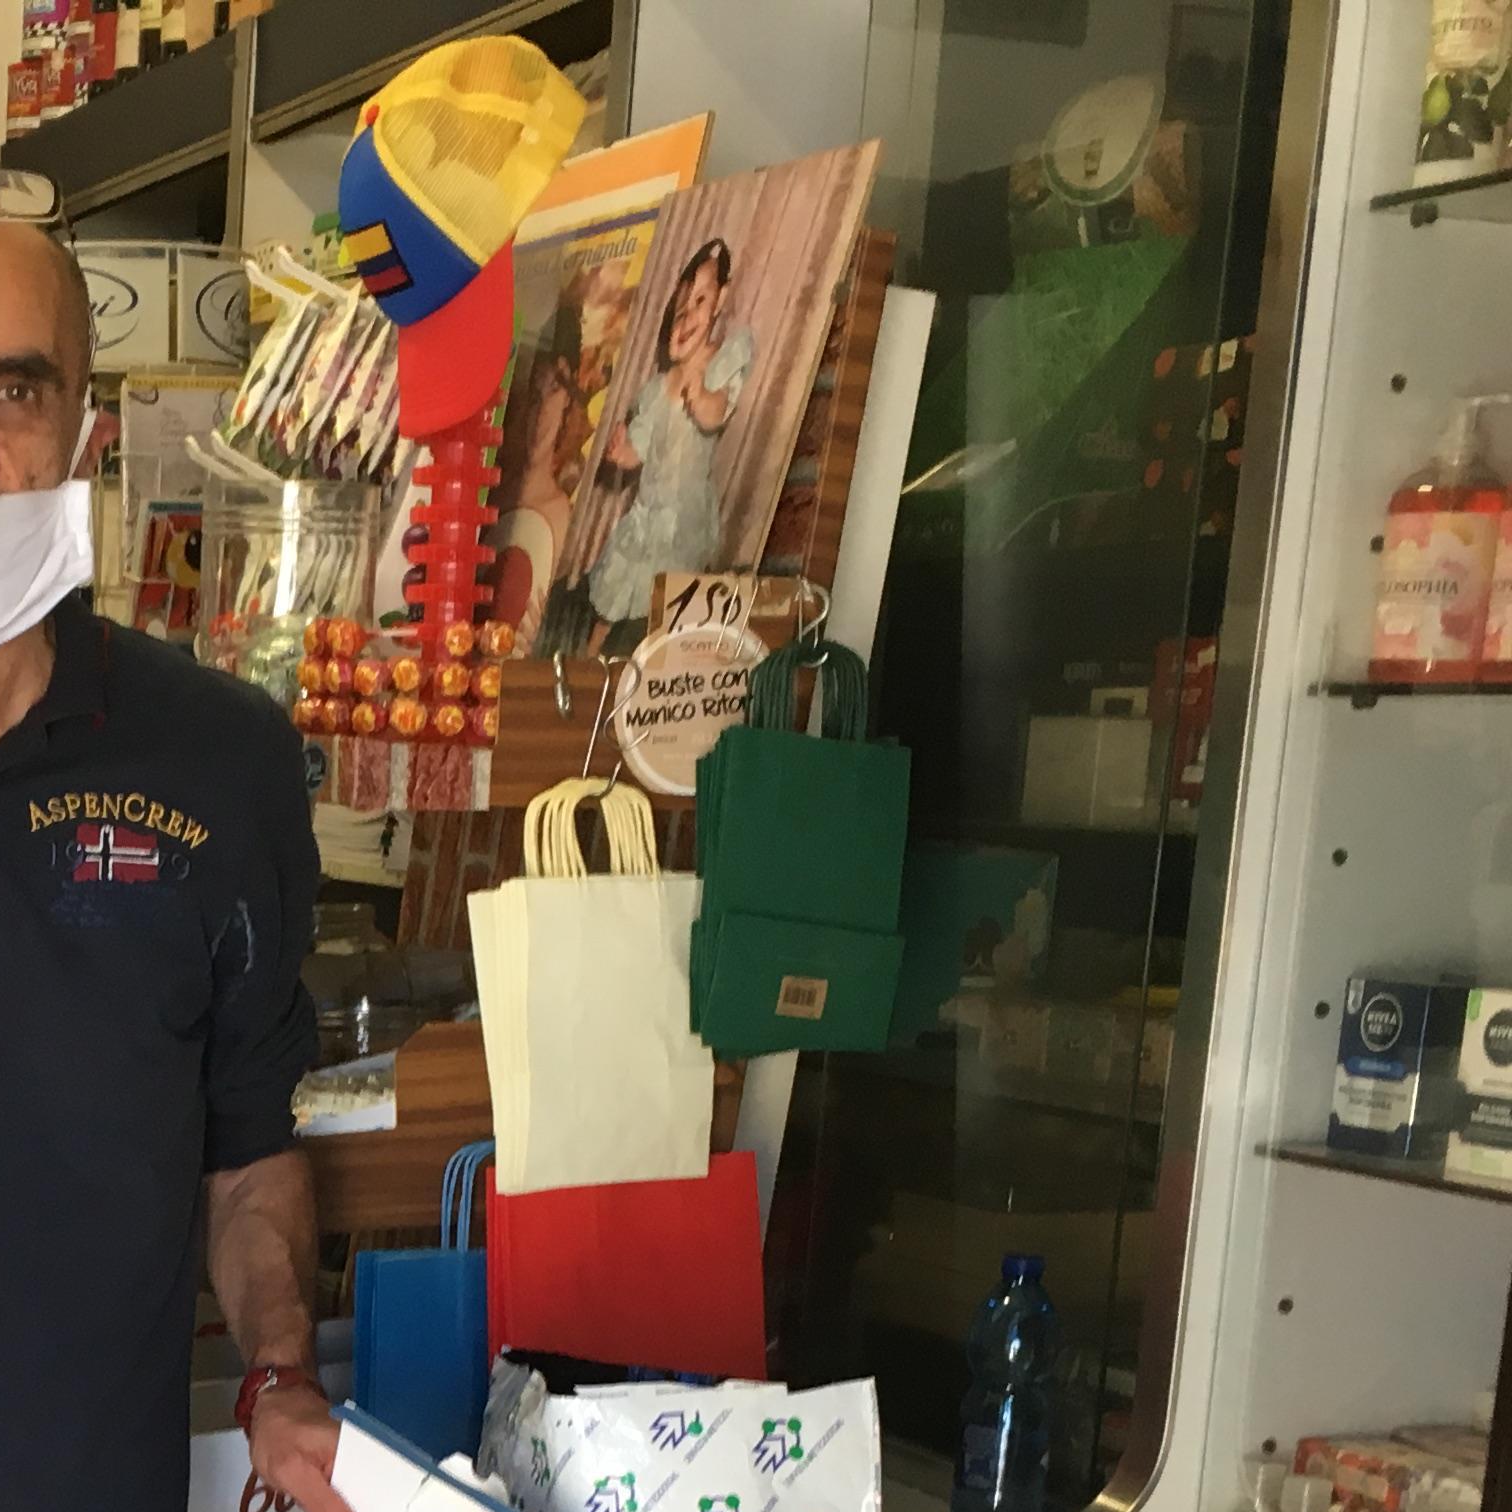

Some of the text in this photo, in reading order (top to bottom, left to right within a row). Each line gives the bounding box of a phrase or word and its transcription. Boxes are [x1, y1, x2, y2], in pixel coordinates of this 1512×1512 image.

[647, 668, 749, 700] Buste con
[626, 700, 696, 728] Manico
[29, 792, 210, 849] ASPENCREW
